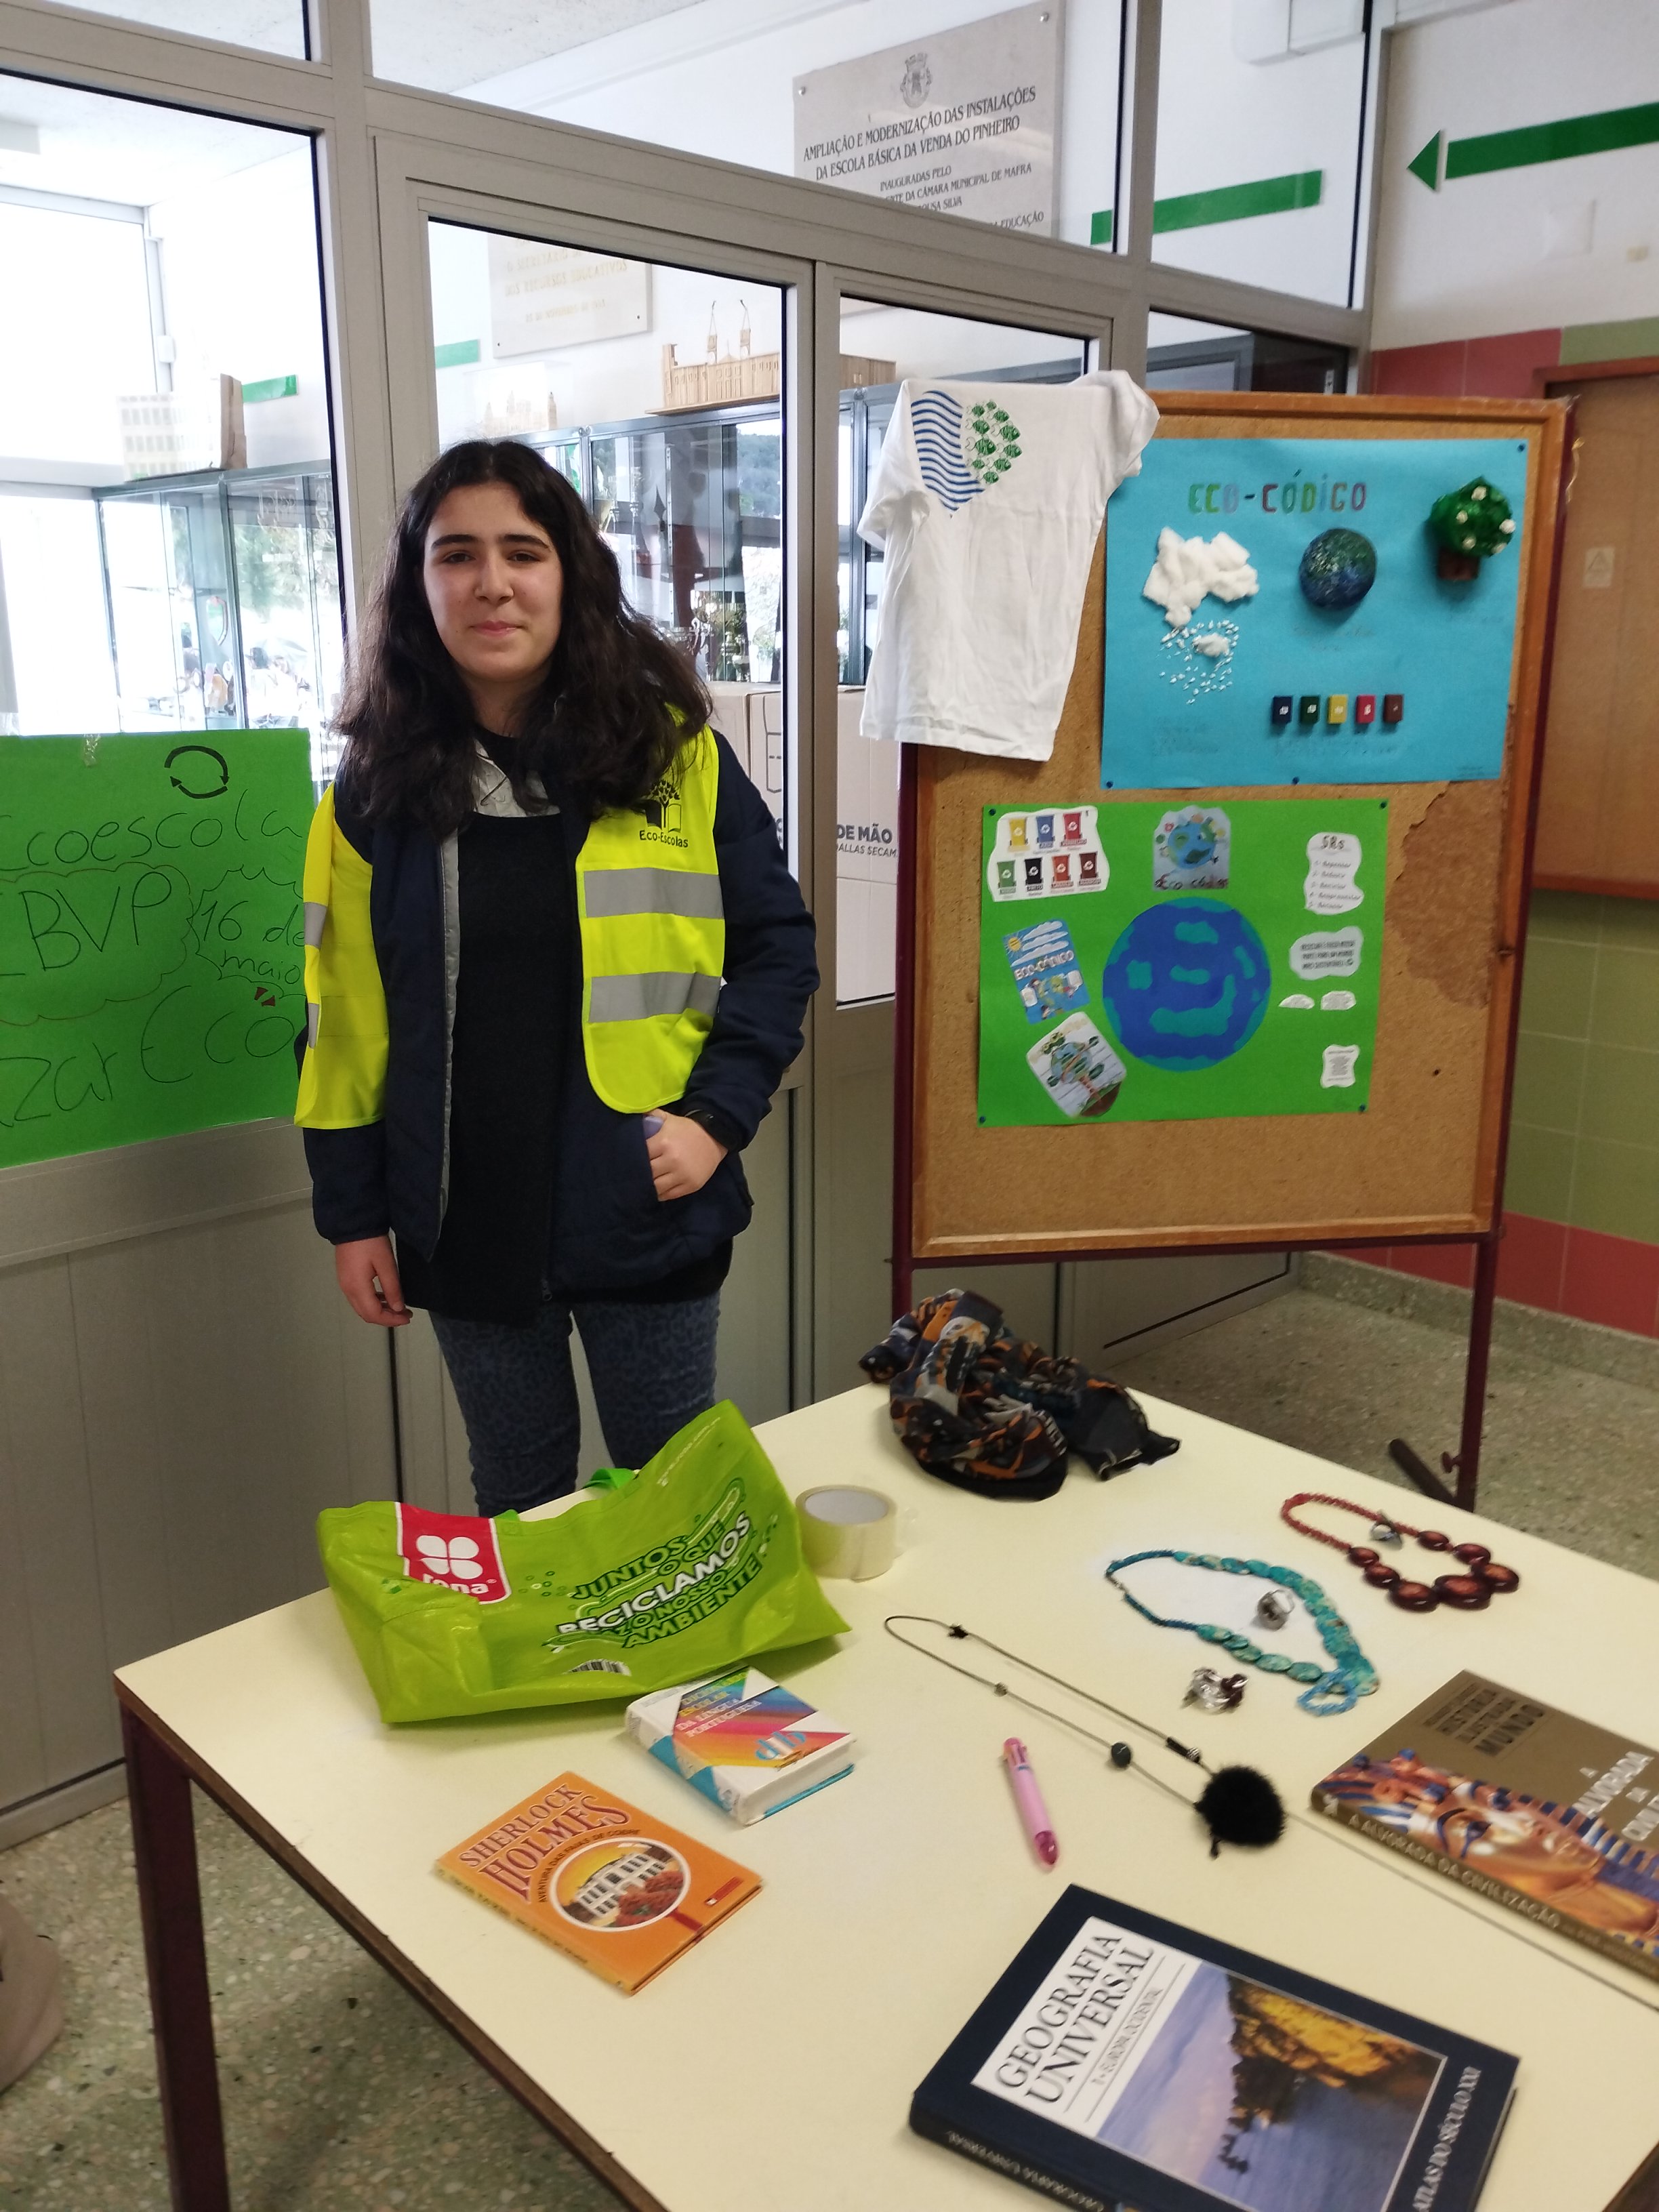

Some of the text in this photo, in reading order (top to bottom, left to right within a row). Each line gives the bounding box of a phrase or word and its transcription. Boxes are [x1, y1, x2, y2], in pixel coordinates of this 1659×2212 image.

[804, 85, 1036, 161] AMPLIAÇÃO E MODERNIZAÇÃO DAS INSTALAÇÕES
[816, 115, 1020, 181] DA ESCOLA BÁSICA DA VENDA DO PINHEIRO
[880, 165, 951, 192] INAUGURADAS PELO
[905, 191, 915, 202] DA
[917, 183, 949, 198] CÂMARA
[951, 173, 989, 190] MUNICIPAL
[991, 169, 1002, 182] DE
[1004, 163, 1032, 178] MAFRA
[943, 196, 962, 209] SILVA
[639, 830, 689, 848] Eco-Escolas
[837, 843, 898, 858] ALLAS SECAM
[858, 822, 893, 844] MÃO
[203, 901, 249, 942] 16
[571, 1536, 688, 1599] JUNTOS
[657, 1520, 726, 1576] O QUE
[621, 1552, 763, 1648] AMBIENTE
[654, 1568, 729, 1618] NOSSO
[458, 1783, 583, 1868] SHERLOCK
[478, 1795, 633, 1904] HOLMES
[995, 1936, 1122, 2088] GEOGRAFIA
[1024, 1948, 1154, 2103] UNIVERSAL
